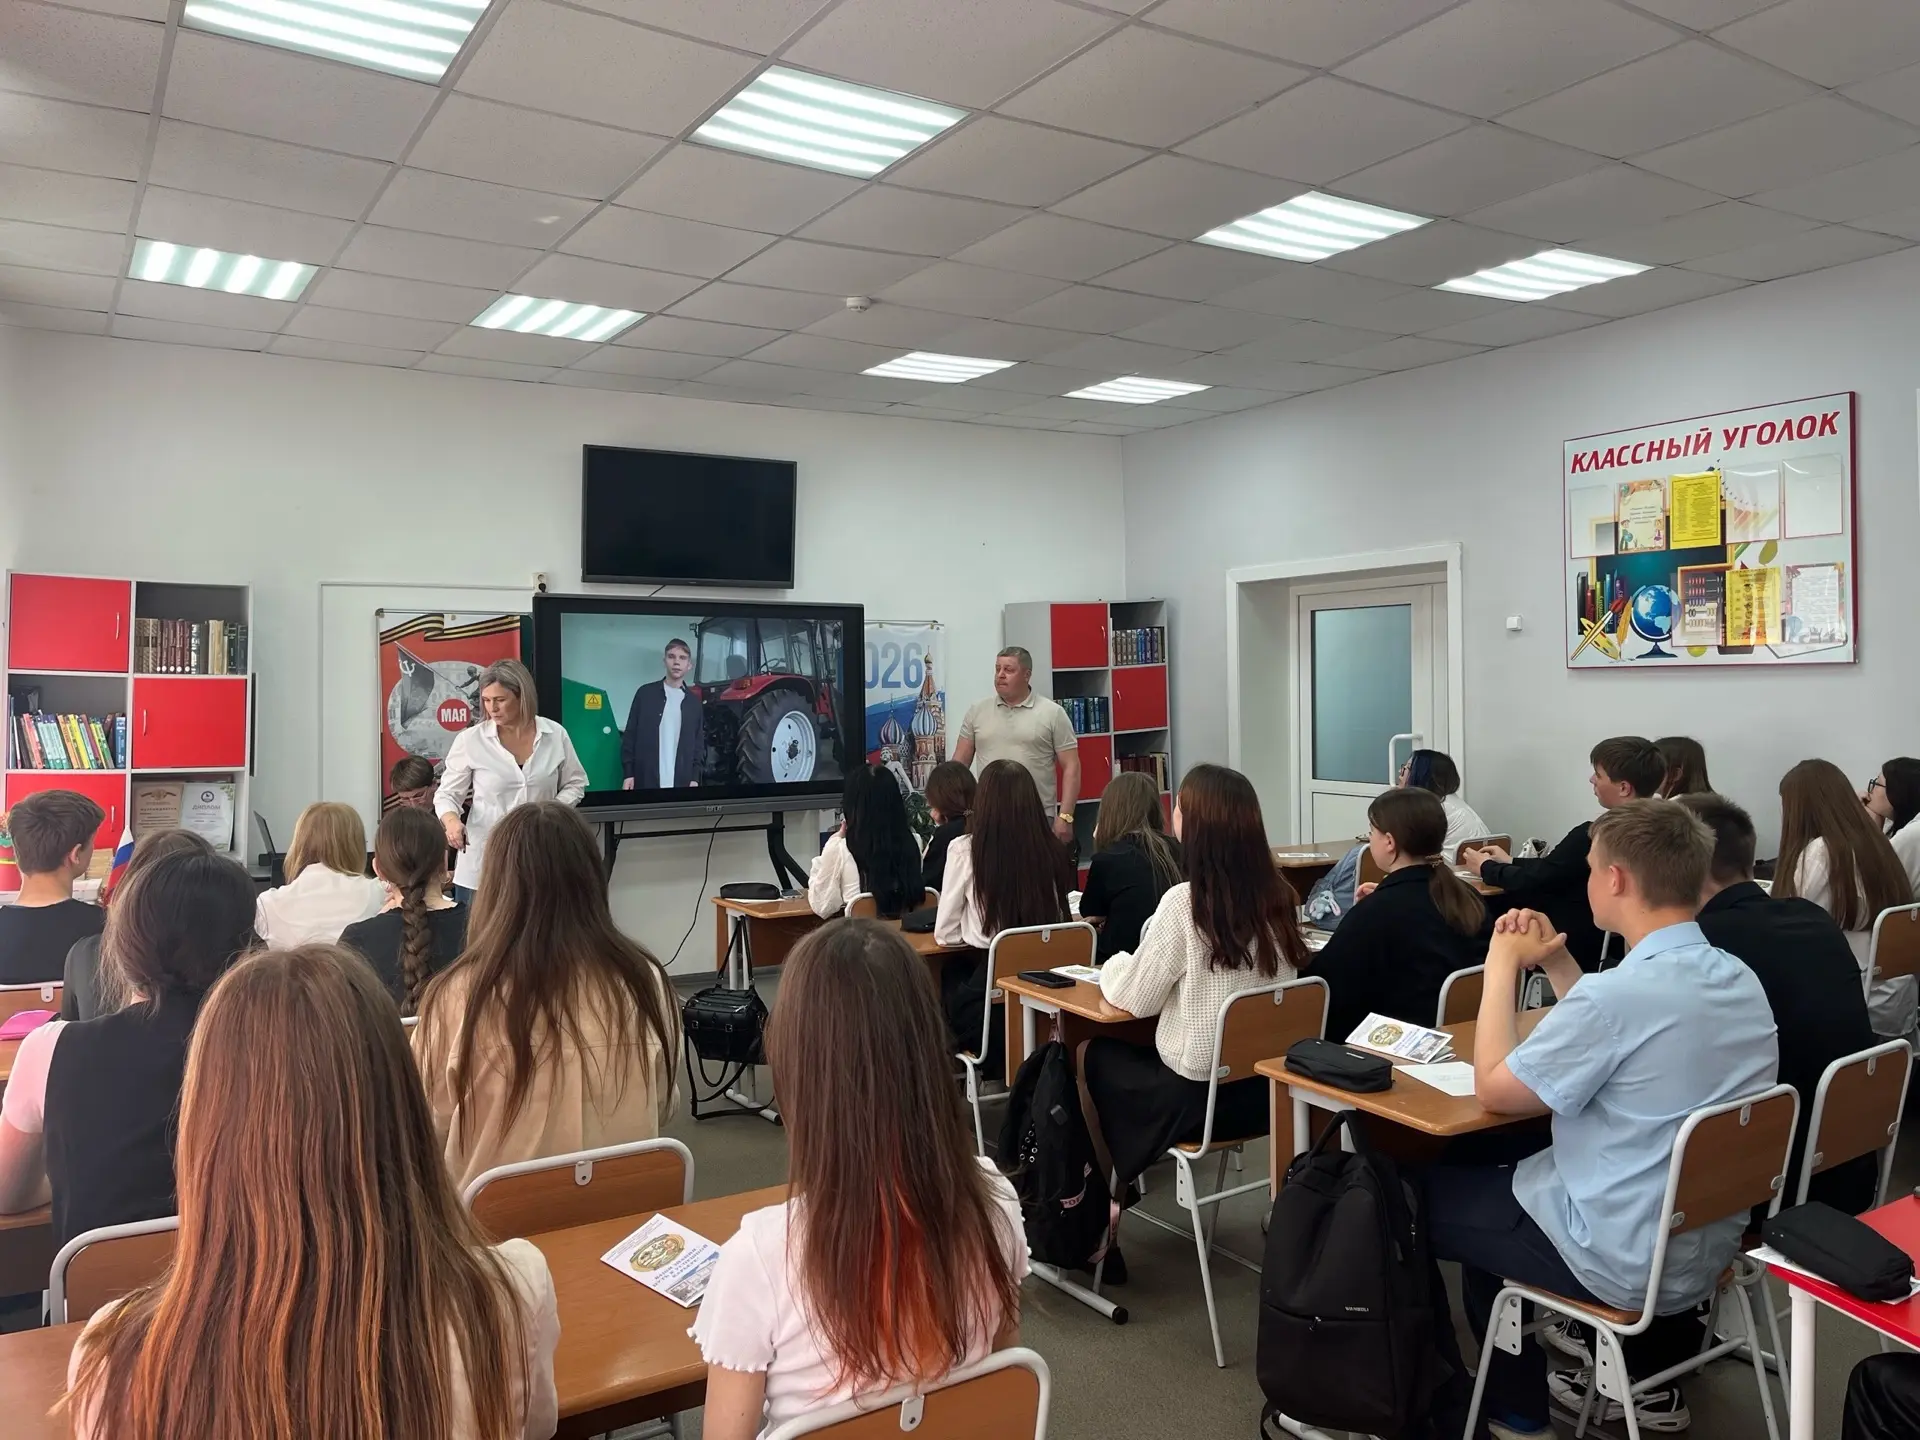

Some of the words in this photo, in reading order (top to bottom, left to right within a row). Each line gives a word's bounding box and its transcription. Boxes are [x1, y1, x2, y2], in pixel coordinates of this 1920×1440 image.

[1571, 427, 1712, 474] КЛАССНЫЙ
[1723, 411, 1840, 450] УГОЛОК
[441, 708, 467, 722] МАЯ
